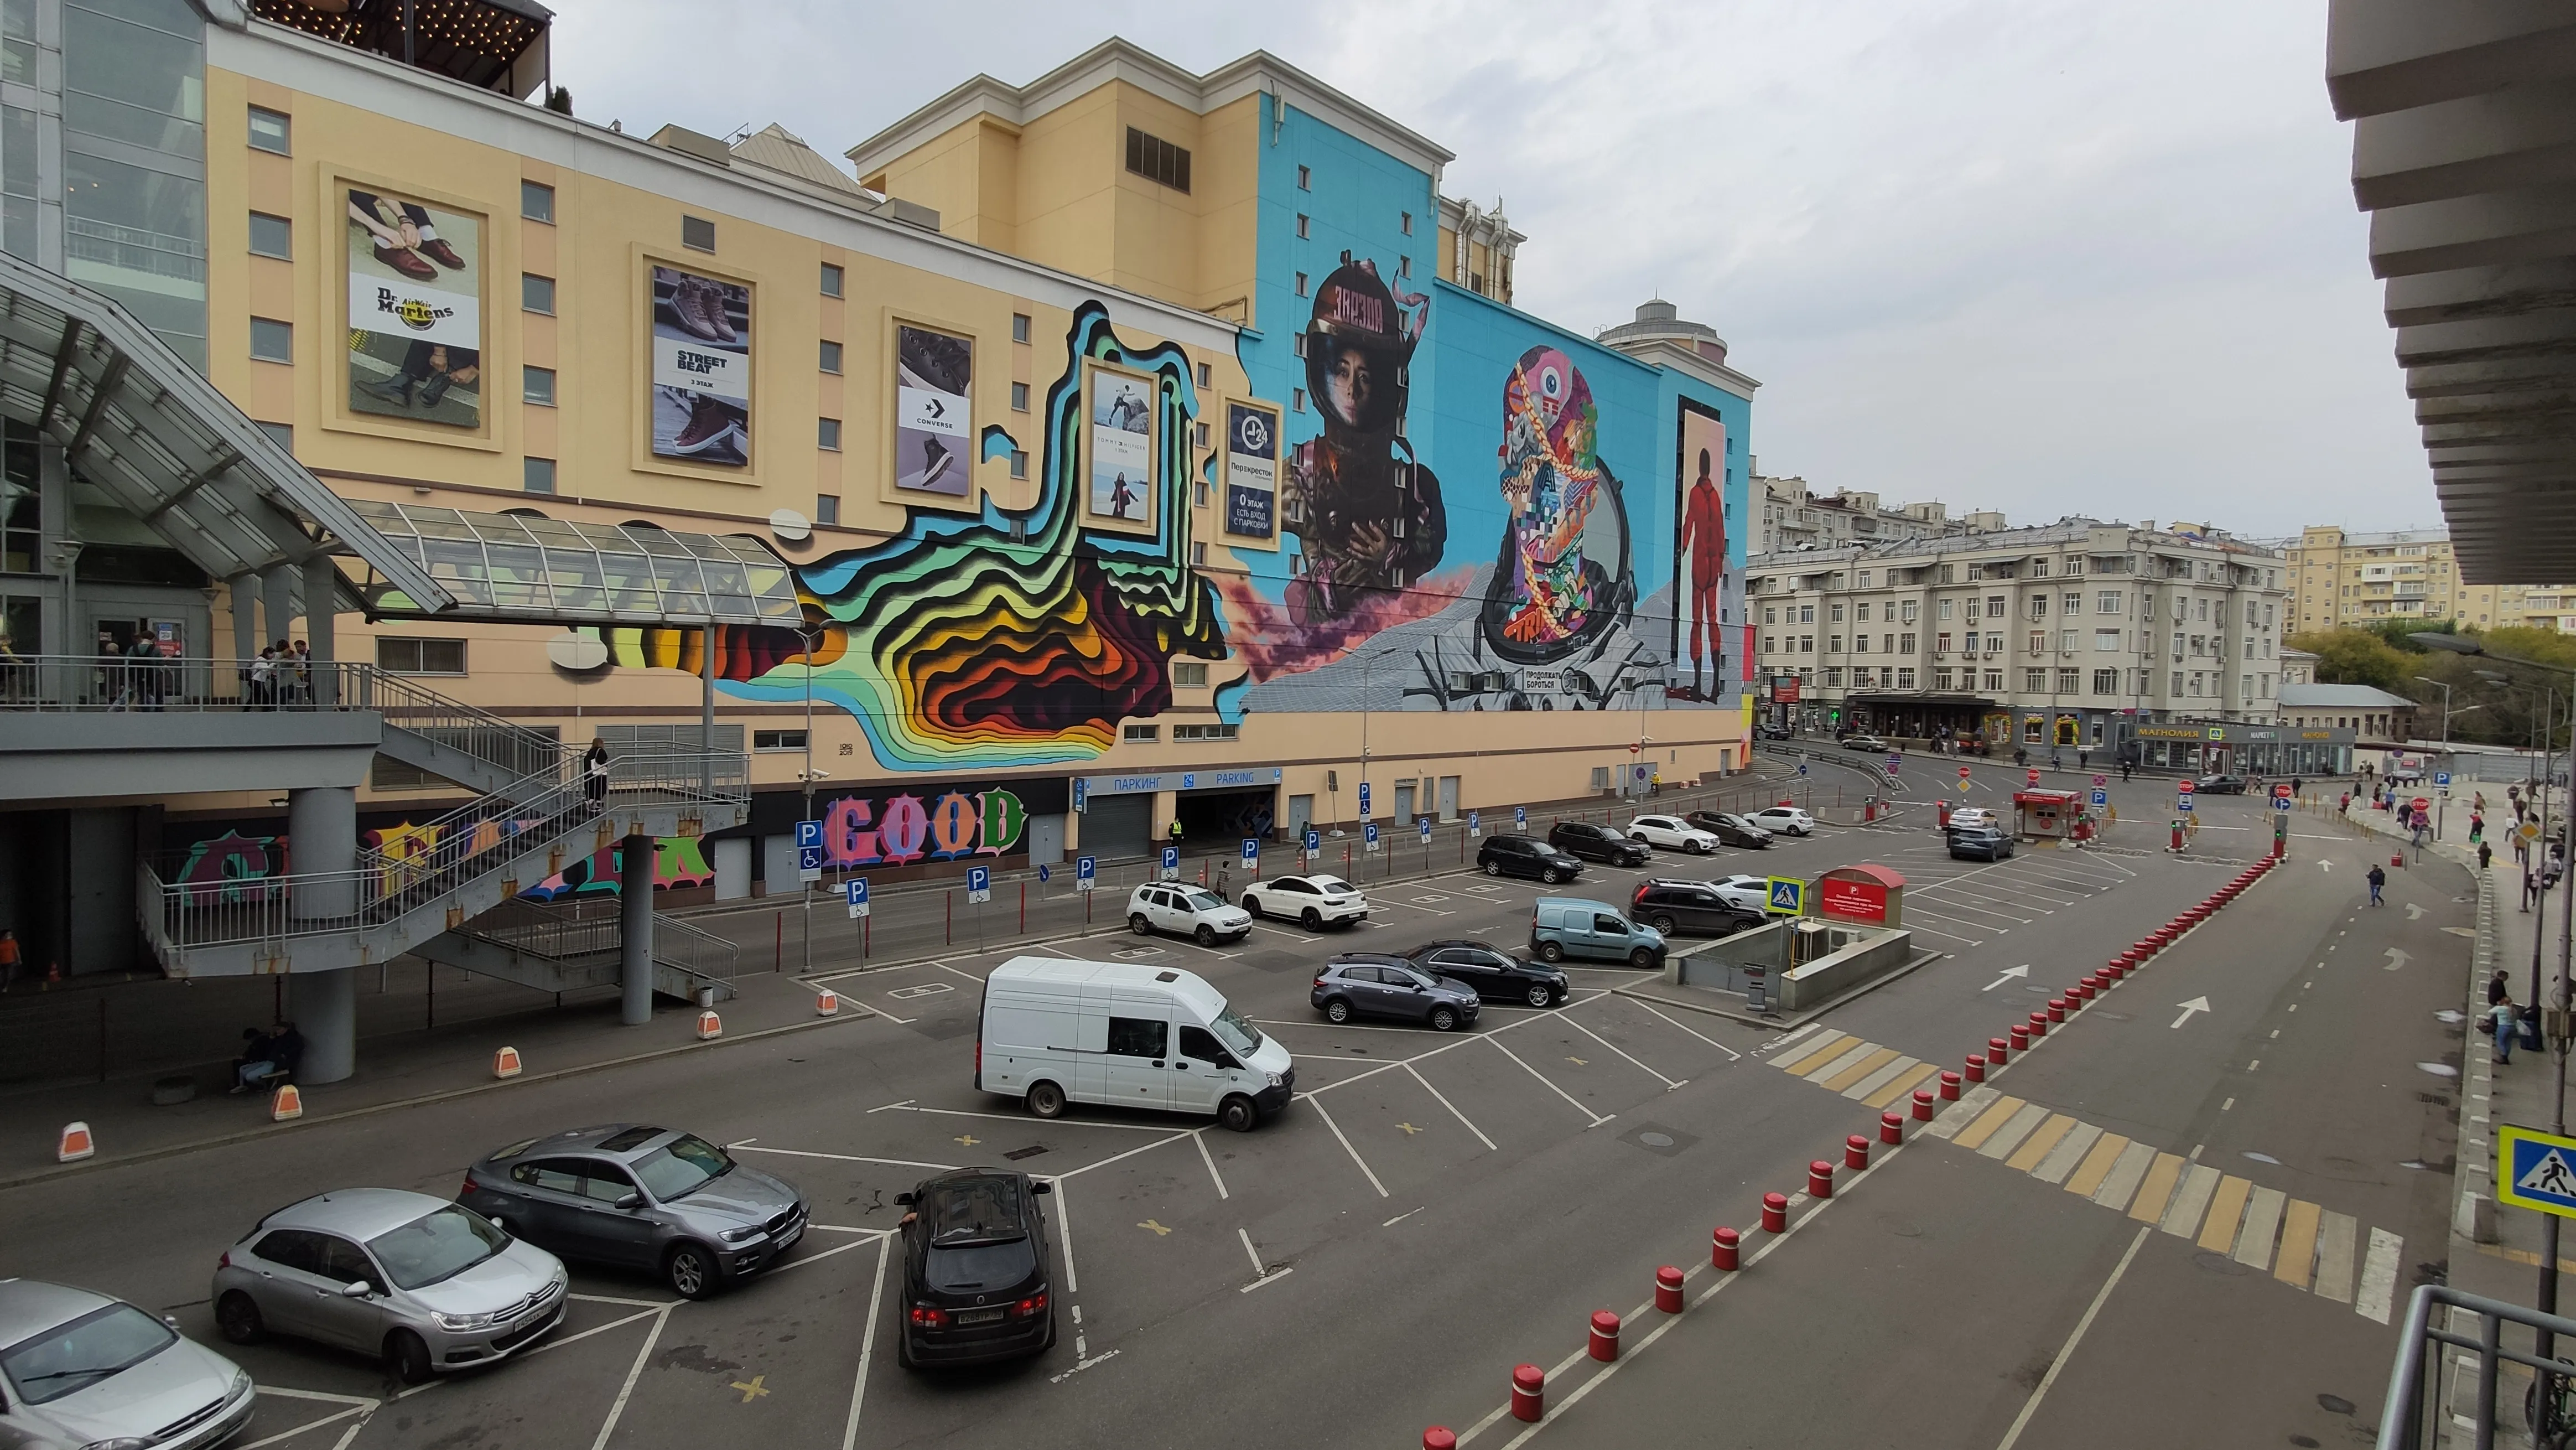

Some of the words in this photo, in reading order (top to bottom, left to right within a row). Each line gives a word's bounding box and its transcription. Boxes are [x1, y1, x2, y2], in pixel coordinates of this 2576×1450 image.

[377, 287, 398, 302] Dr.
[377, 299, 454, 319] Martens
[678, 350, 727, 368] STREET
[678, 359, 711, 374] BEAT
[917, 418, 953, 429] CONVERSE
[1256, 429, 1268, 444] 24
[1231, 462, 1273, 477] Перекресток
[1240, 494, 1247, 506] 0
[1247, 499, 1264, 509] ЭТАЖ
[1237, 508, 1250, 517] ЕСТЬ
[1250, 510, 1266, 521] ВХОД
[1239, 518, 1268, 530] ПАРКОВКИ
[1526, 671, 1562, 680] ПРОДОЛЖАТЬ
[1526, 680, 1555, 688] БОРОТЬСЯ
[2138, 728, 2199, 738] МАГНОЛИЯ
[1114, 777, 1162, 791] ПАРКИНГ
[1217, 772, 1254, 784] PARKING
[2437, 773, 2447, 783] P
[1361, 784, 1368, 798] P
[2094, 793, 2103, 802] P
[1077, 794, 1082, 803] P
[1471, 814, 1477, 827] P
[1518, 809, 1523, 821] P
[1368, 826, 1375, 841] P
[1422, 820, 1428, 833] P
[802, 824, 816, 845] P
[1309, 833, 1317, 848] P
[1245, 841, 1255, 857] P
[1166, 850, 1175, 866] P
[1081, 859, 1092, 877] P
[973, 869, 985, 889] P
[852, 881, 864, 902] P
